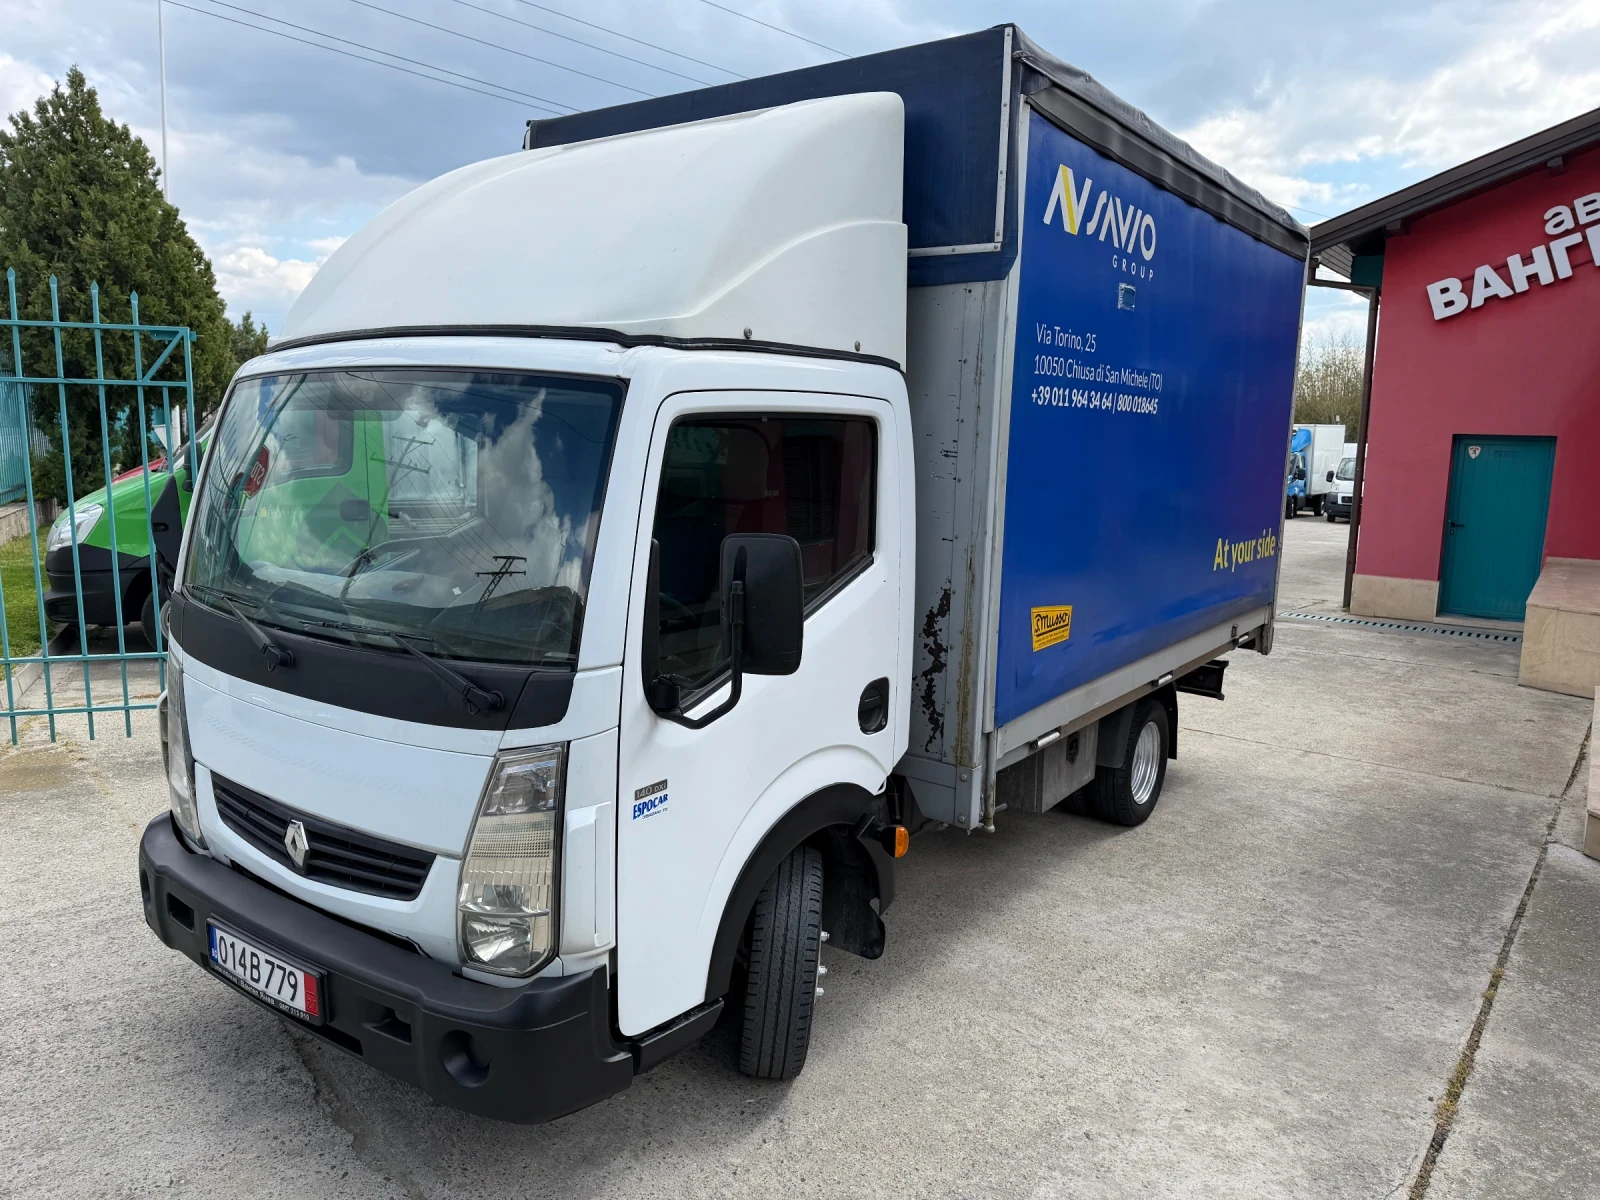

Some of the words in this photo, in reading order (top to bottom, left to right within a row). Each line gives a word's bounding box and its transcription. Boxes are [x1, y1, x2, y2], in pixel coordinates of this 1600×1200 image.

[1086, 190, 1156, 261] SAVIO
[1112, 254, 1154, 281] GROUP
[1036, 322, 1052, 345] Via
[1054, 326, 1084, 353] Torino,
[1085, 333, 1097, 353] 25
[1034, 354, 1065, 377] 10050
[1066, 359, 1095, 381] Chiusa
[1096, 363, 1105, 382] di
[1105, 365, 1120, 385] San
[1120, 367, 1148, 389] Michele
[1148, 372, 1163, 393] (TO)
[1031, 385, 1051, 406] +39
[1052, 386, 1070, 407] 011
[1071, 388, 1089, 409] 964
[1089, 390, 1101, 410] 34
[1101, 392, 1113, 411] 64
[1117, 394, 1132, 413] 800
[1132, 395, 1159, 415] 018645
[1213, 538, 1230, 571] At
[1231, 539, 1256, 573] your
[1257, 528, 1276, 560] side
[633, 793, 668, 820] ESPOCAR
[636, 787, 653, 799] 140
